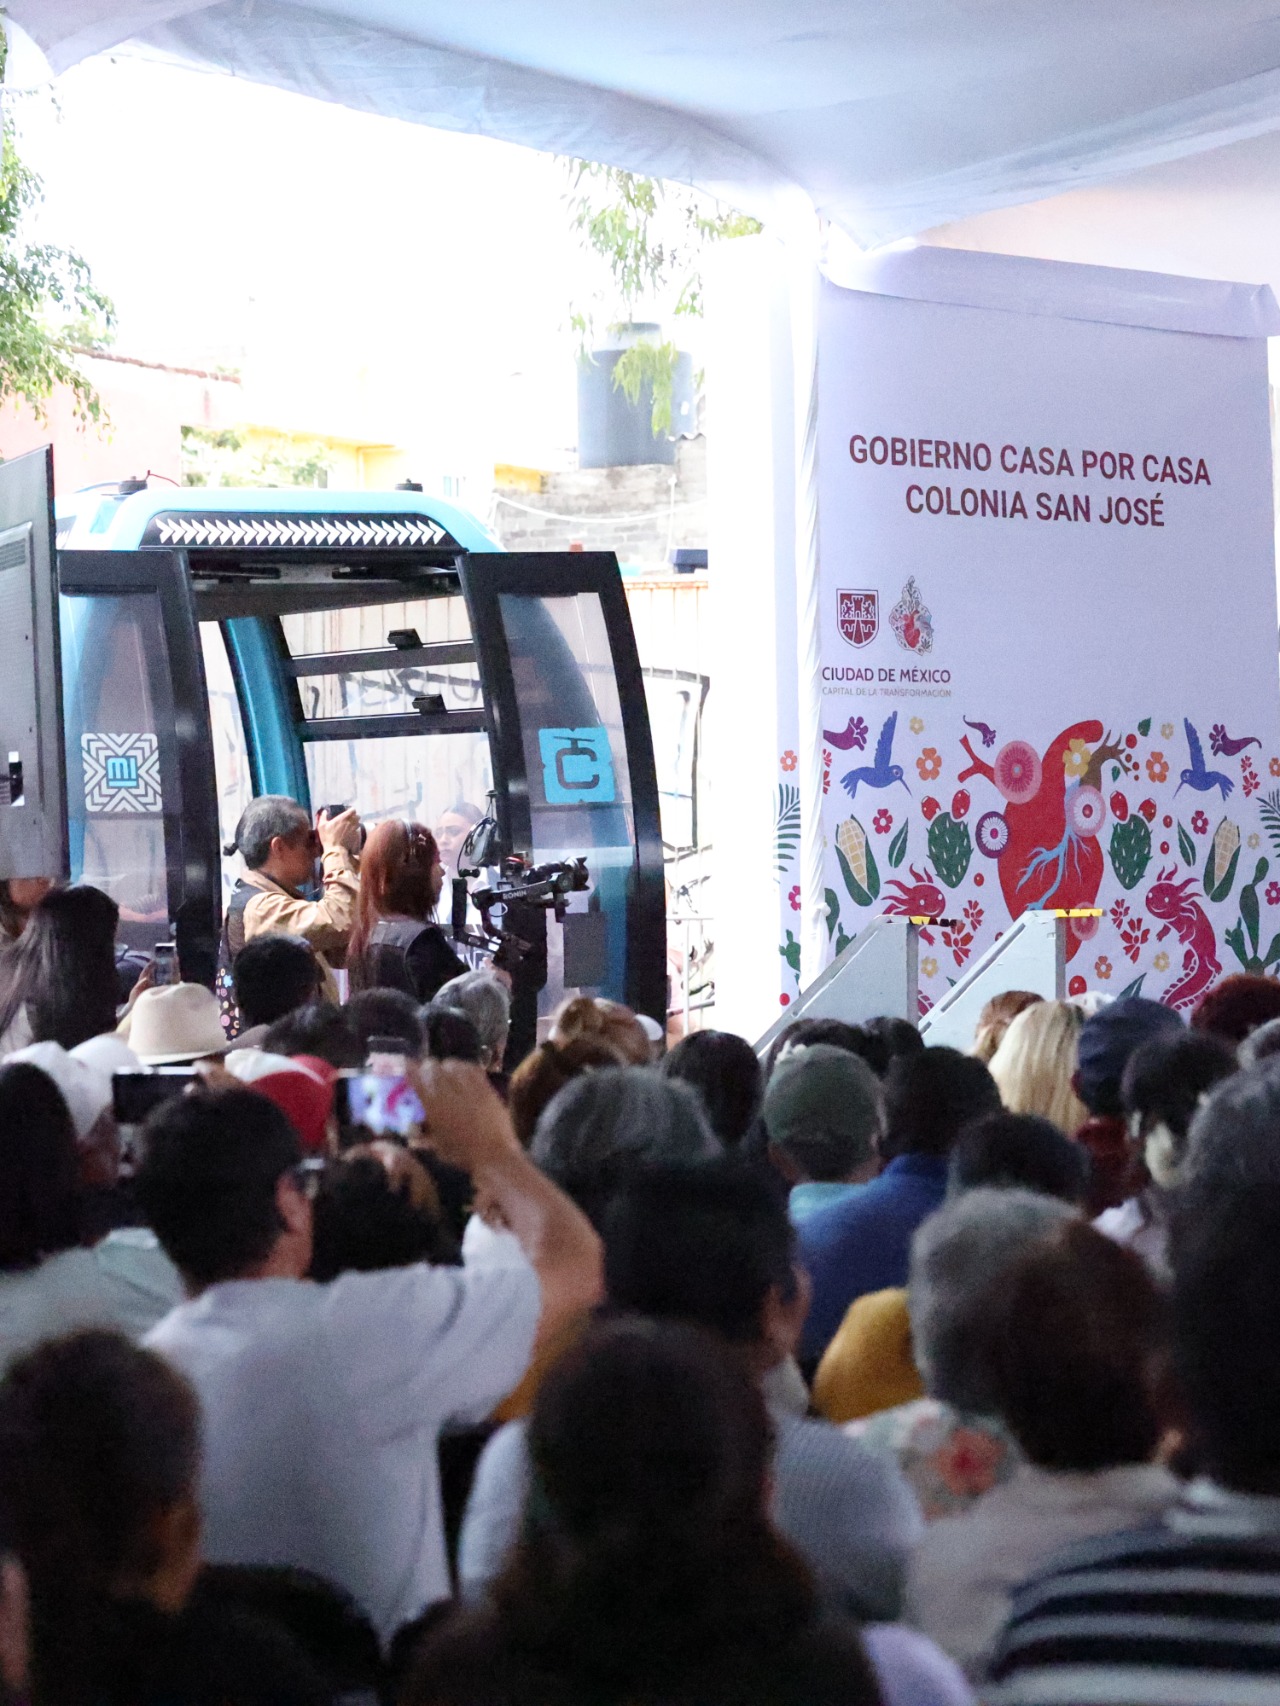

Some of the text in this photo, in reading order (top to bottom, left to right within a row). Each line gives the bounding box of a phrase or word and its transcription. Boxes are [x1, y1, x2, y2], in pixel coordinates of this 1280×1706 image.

[849, 434, 1212, 486] GOBIERNO CASA POR CASA
[905, 484, 1165, 527] COLONIA SAN JOSÉ
[821, 665, 951, 684] CIUDAD DE MÉXICO
[821, 686, 952, 698] CAPITAL DE LA TRANSFORMACIÓN
[502, 889, 528, 900] RONIN
